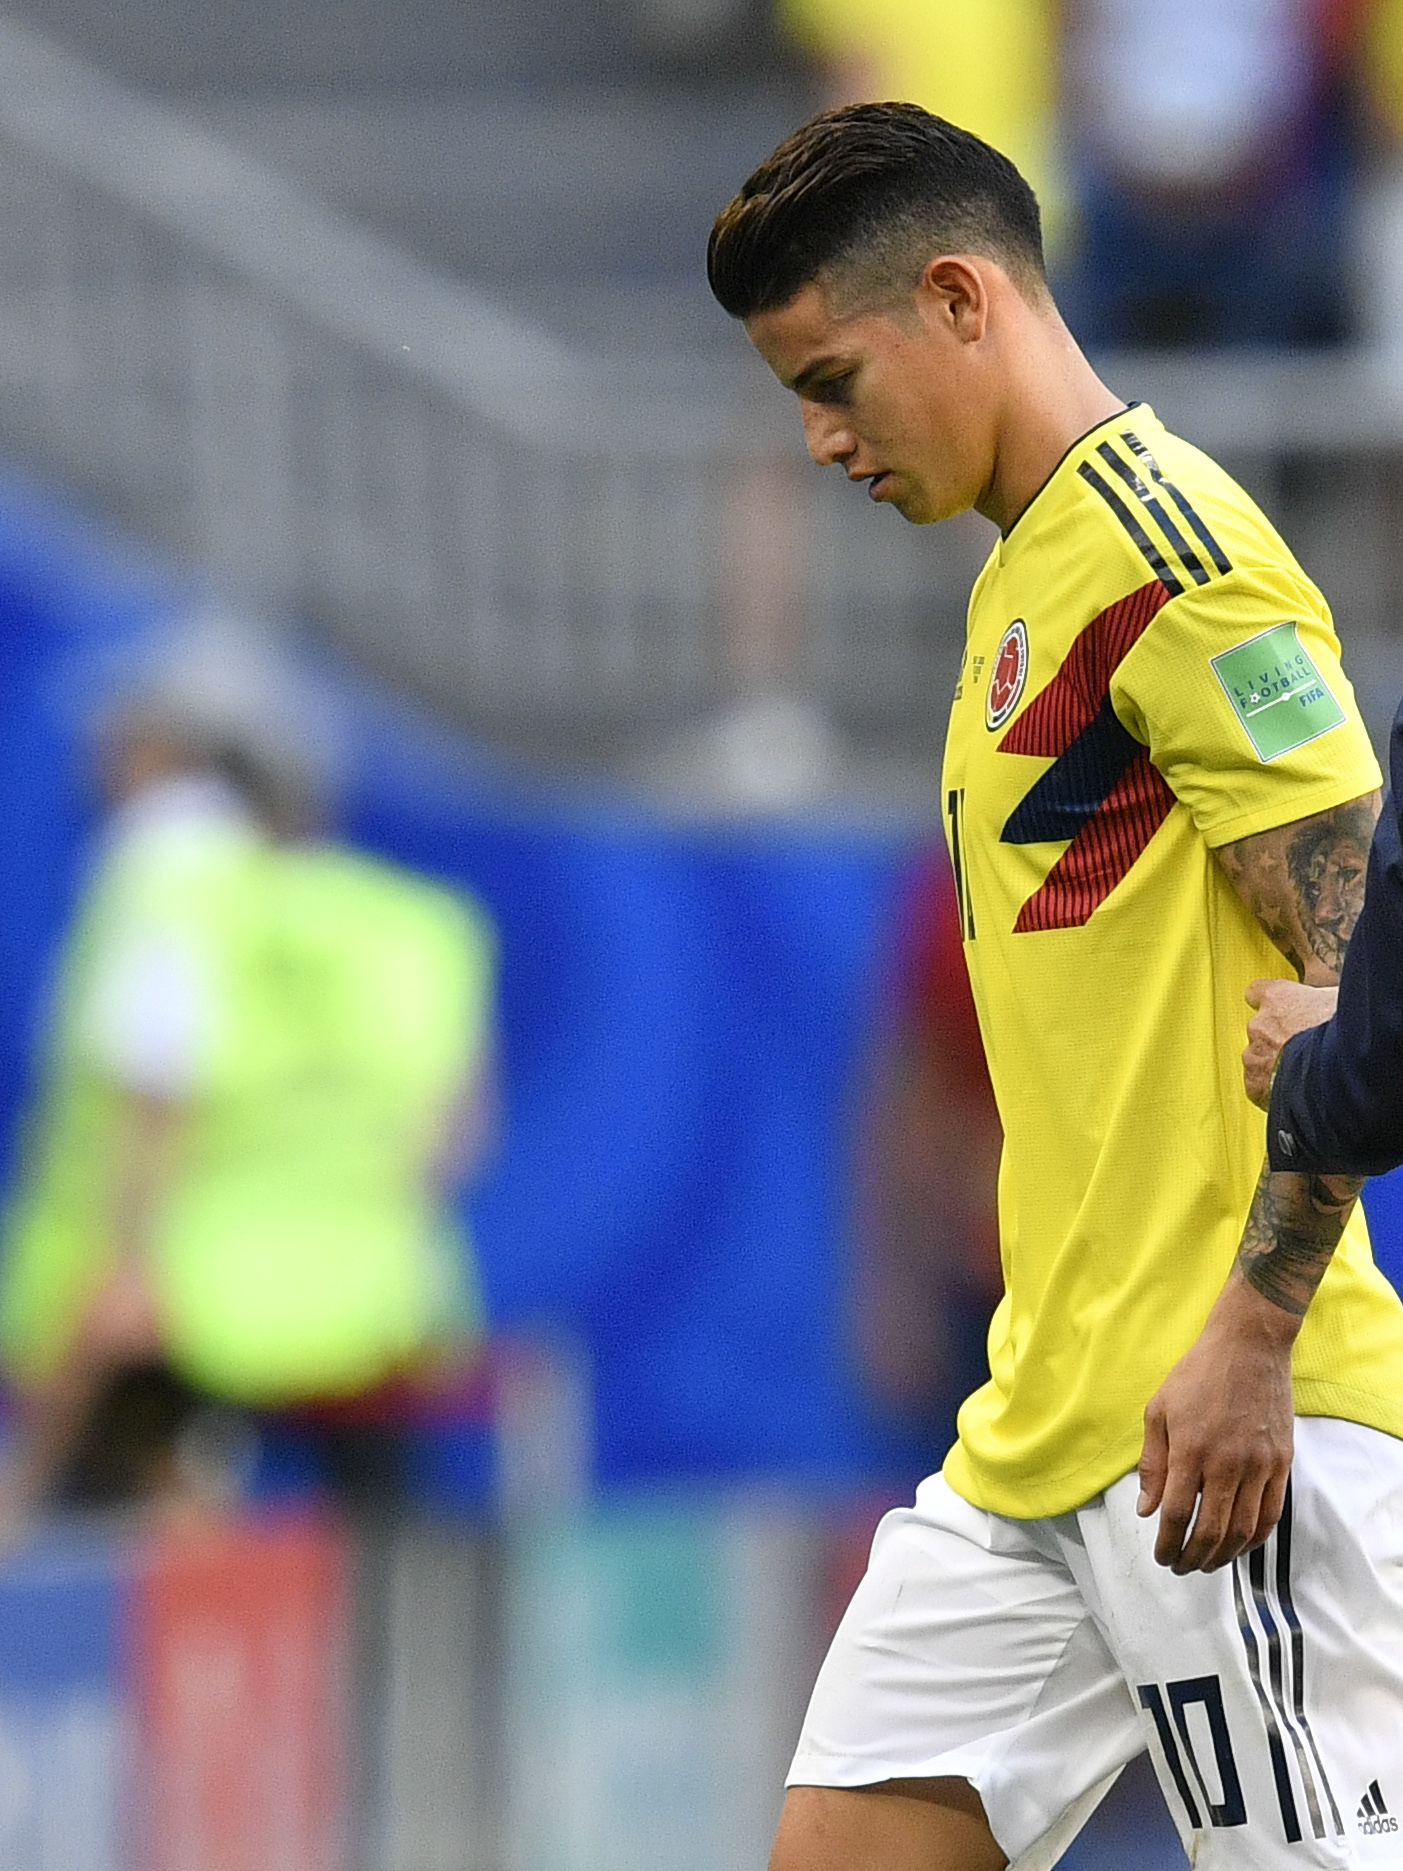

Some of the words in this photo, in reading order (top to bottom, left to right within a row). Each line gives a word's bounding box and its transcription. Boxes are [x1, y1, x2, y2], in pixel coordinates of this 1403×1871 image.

[1233, 654, 1304, 698] LIVING
[1298, 687, 1325, 708] FIFA
[1136, 1674, 1248, 1829] 10
